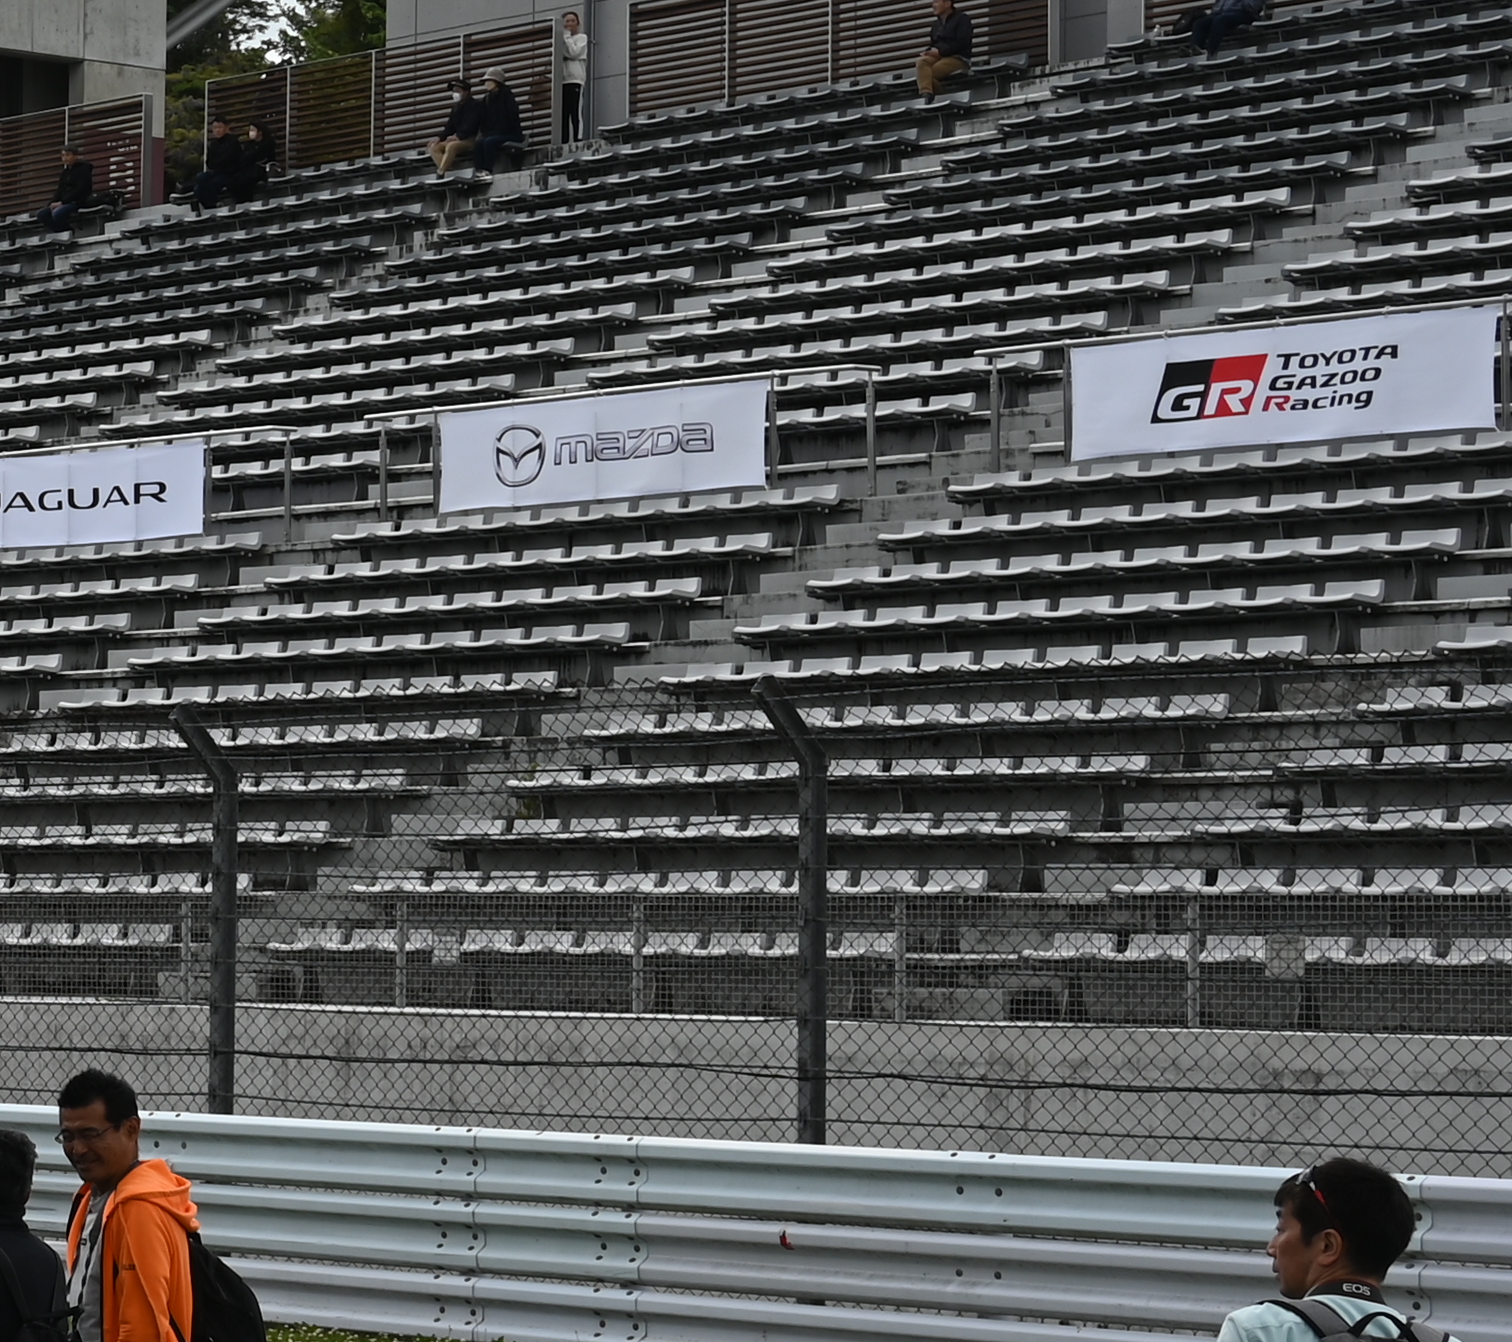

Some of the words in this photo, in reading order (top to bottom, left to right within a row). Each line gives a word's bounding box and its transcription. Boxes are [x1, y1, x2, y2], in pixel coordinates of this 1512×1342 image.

[1276, 344, 1399, 367] TOYOTA
[1156, 379, 1257, 421] GR
[1268, 366, 1383, 392] GAZOO
[1262, 390, 1374, 413] Racing
[1342, 1282, 1371, 1296] EOS
